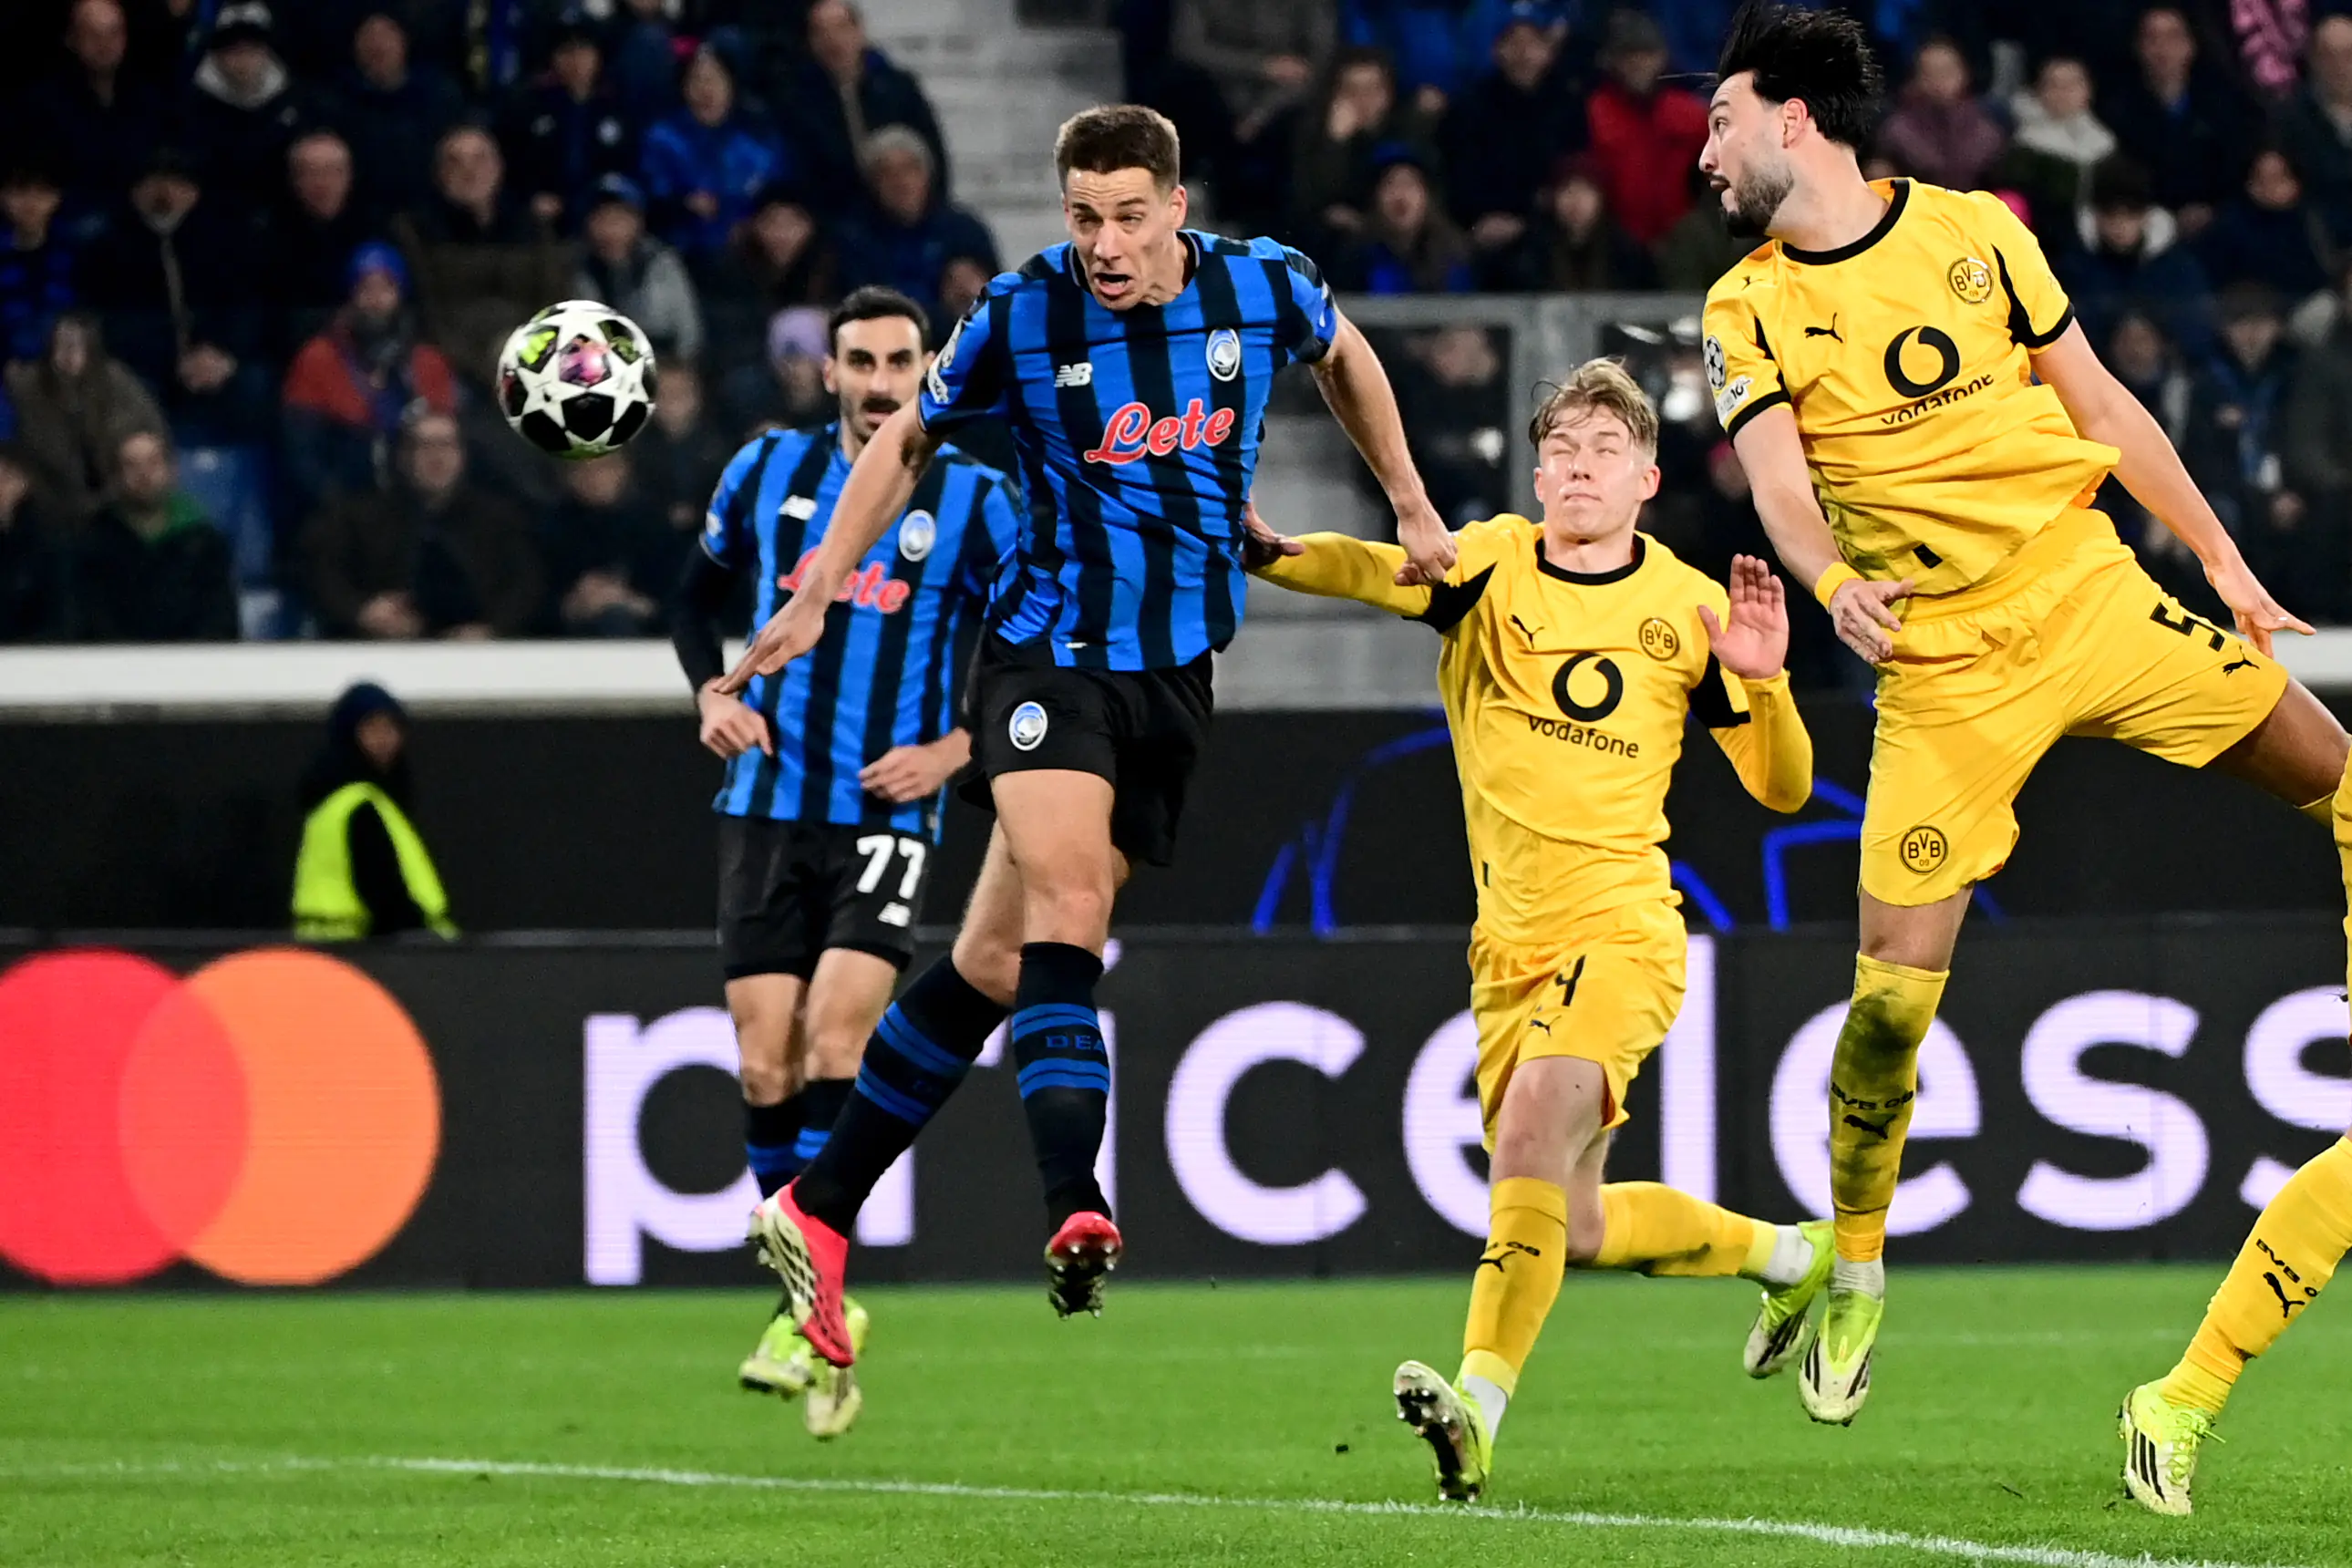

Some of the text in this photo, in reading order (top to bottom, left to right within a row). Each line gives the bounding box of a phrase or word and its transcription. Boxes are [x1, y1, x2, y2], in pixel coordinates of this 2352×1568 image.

[1084, 397, 1235, 465] Lete
[1645, 624, 1674, 650] BVB
[1527, 715, 1640, 758] vodafone
[856, 834, 926, 900] 77
[1908, 832, 1941, 859] BVB
[1554, 954, 1587, 1007] 4
[2255, 1238, 2301, 1284] BVB
